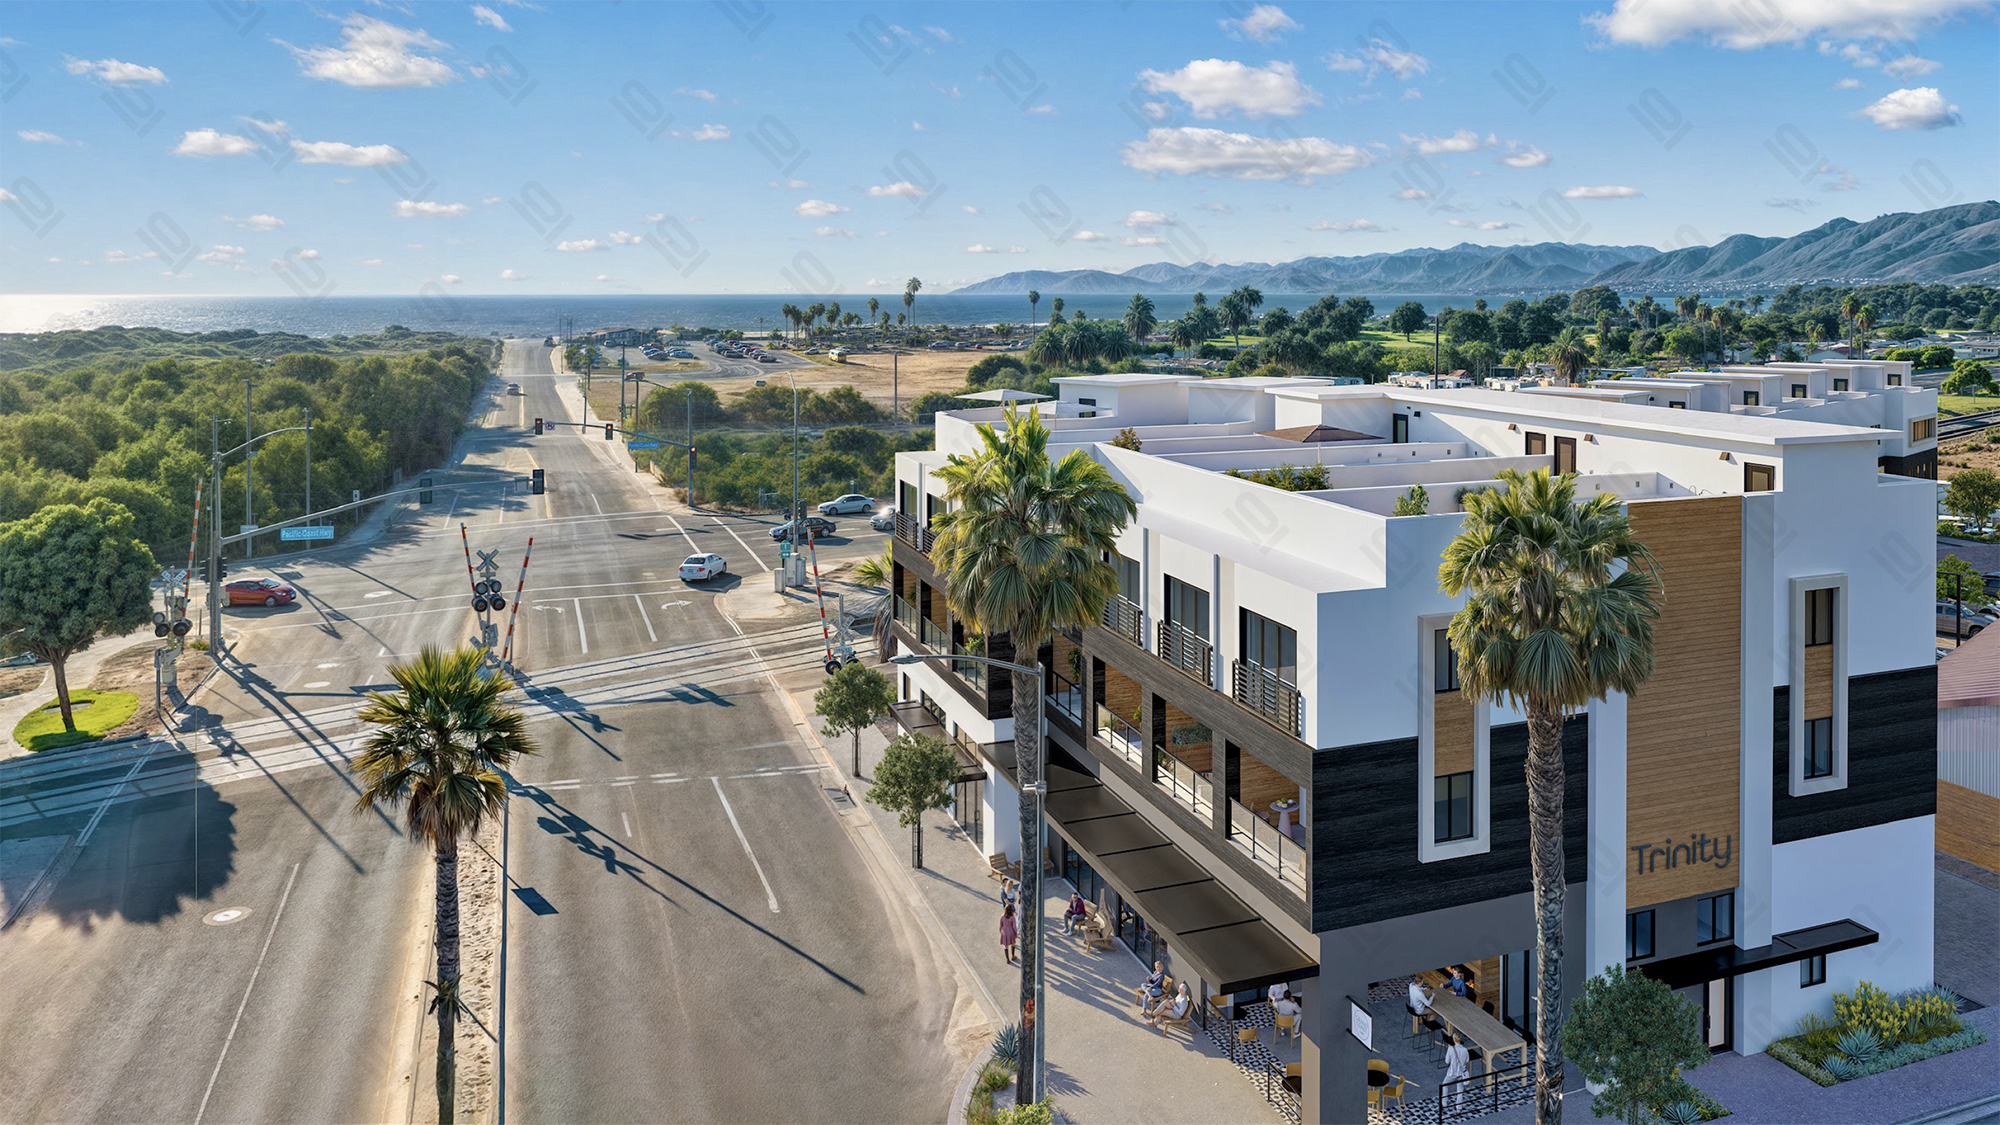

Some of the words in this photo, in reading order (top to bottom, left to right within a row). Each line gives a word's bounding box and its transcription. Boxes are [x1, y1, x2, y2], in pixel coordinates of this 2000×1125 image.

[282, 530, 301, 538] Pacific
[302, 529, 319, 538] Coast
[320, 528, 333, 538] Hwy
[1631, 833, 1731, 875] Trinity
